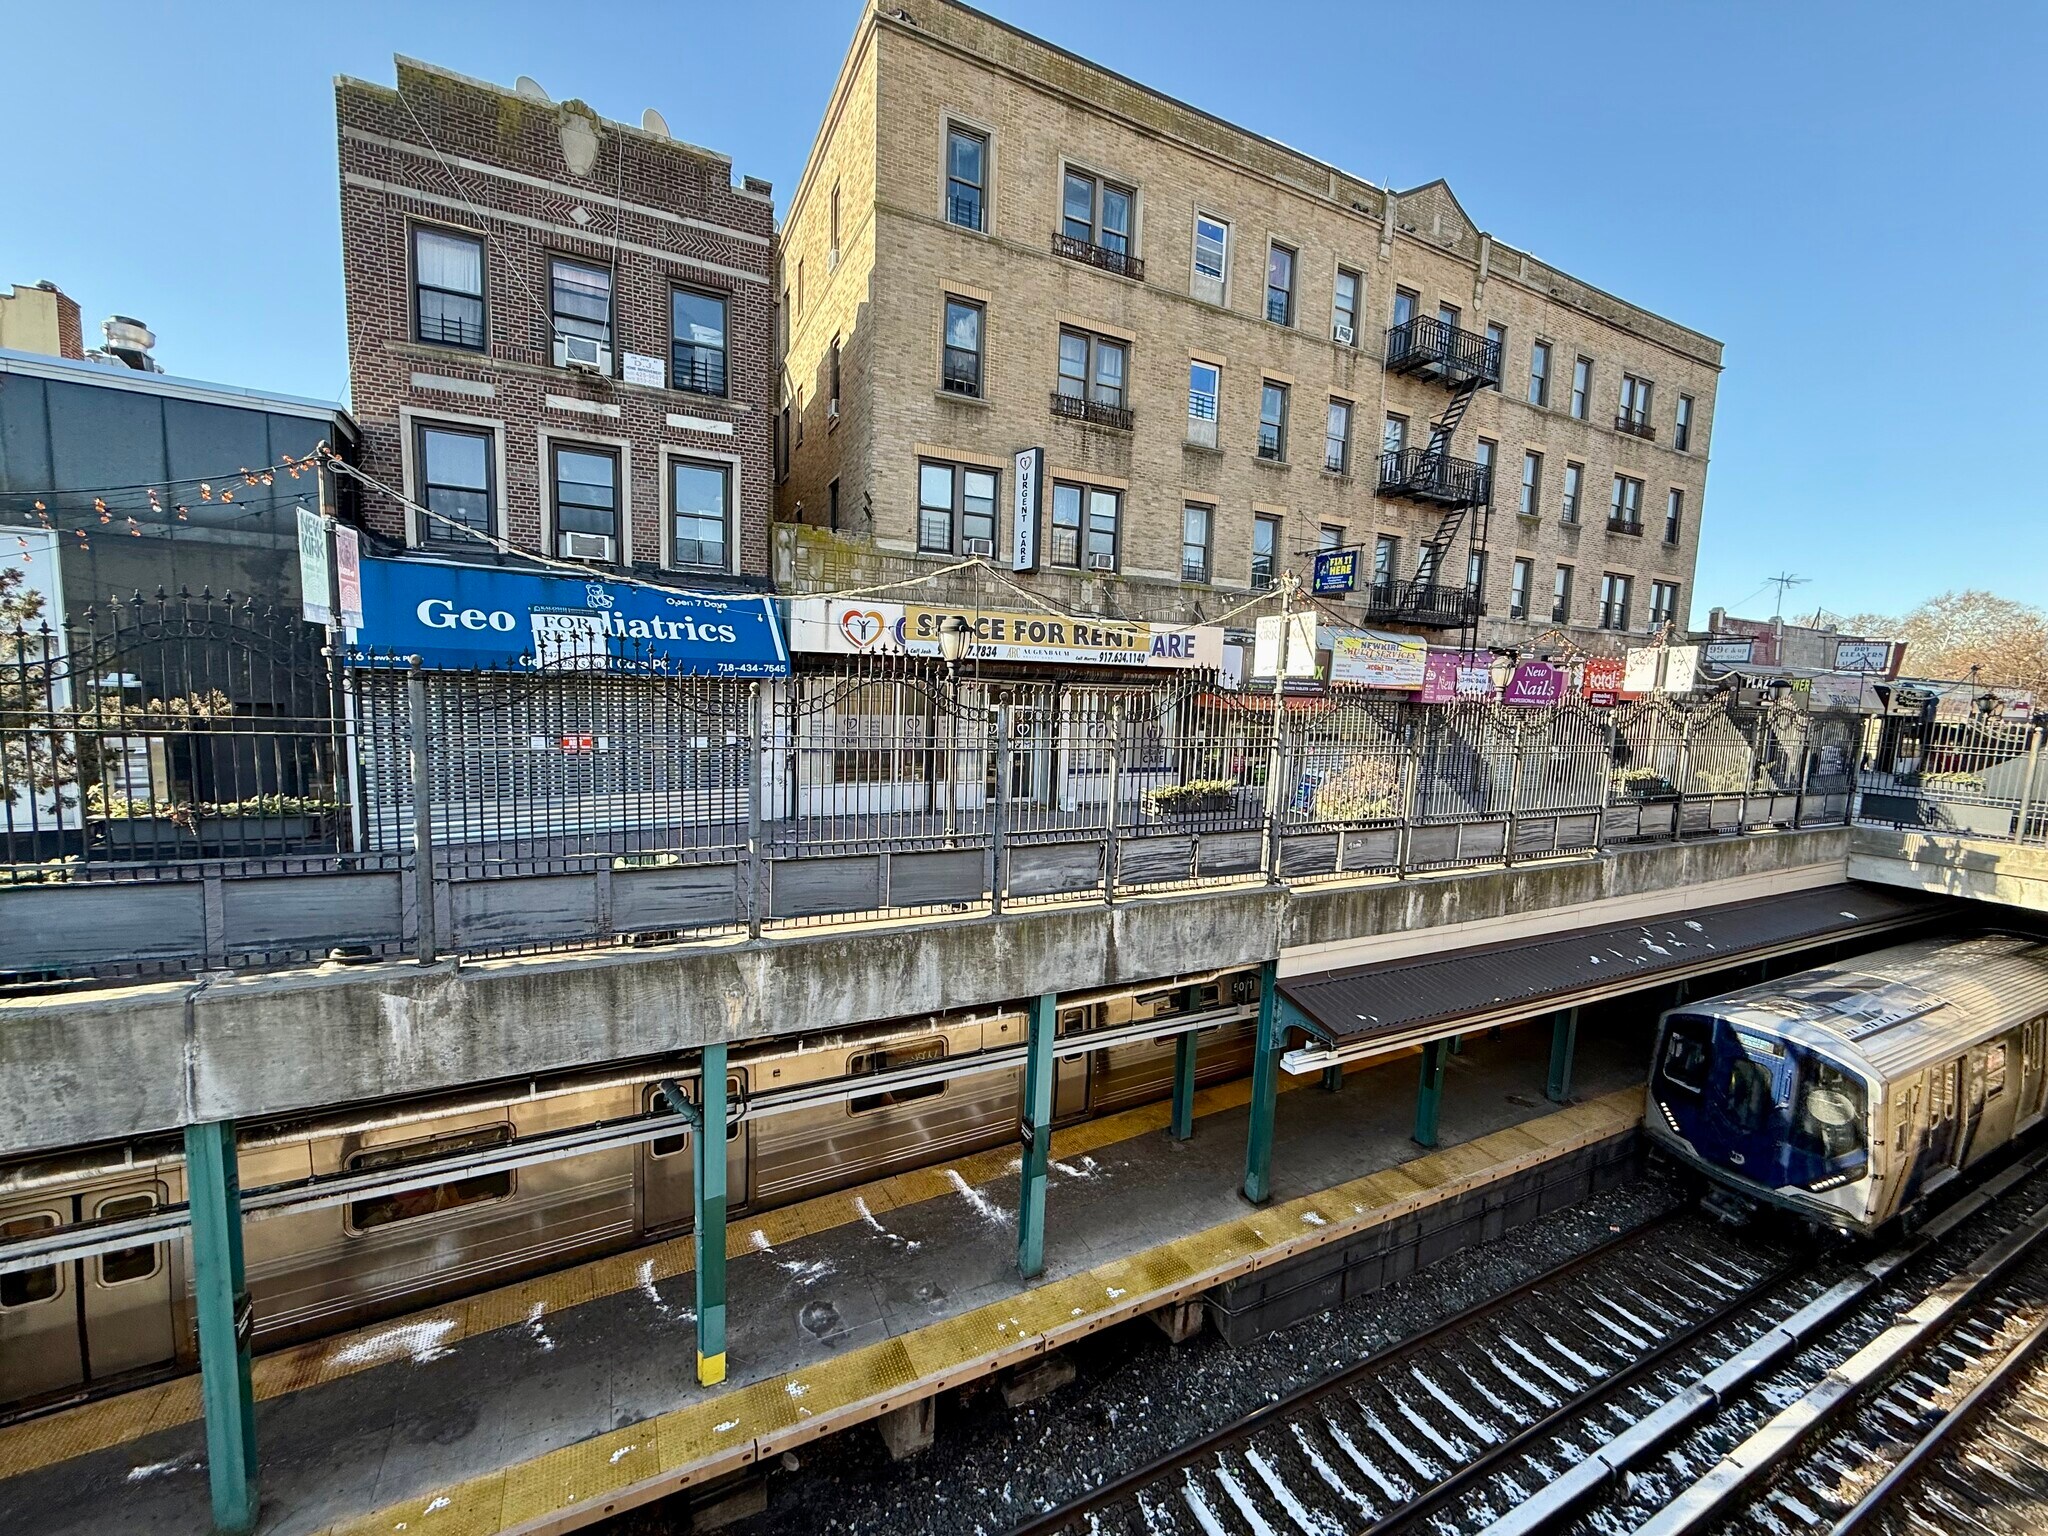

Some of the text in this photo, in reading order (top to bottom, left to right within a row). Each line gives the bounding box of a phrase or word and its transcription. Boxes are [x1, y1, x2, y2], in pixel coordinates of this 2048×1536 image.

[300, 512, 322, 540] NEW
[302, 532, 325, 559] KIRK
[1330, 555, 1353, 567] FIX IT
[1329, 564, 1352, 576] HERE
[666, 597, 694, 607] Open
[703, 600, 728, 609] Days
[417, 599, 516, 632] Geo
[543, 616, 590, 629] FOR
[917, 613, 1005, 640] SCE
[1014, 620, 1065, 644] FOR
[1073, 624, 1138, 647] RENT
[1151, 634, 1196, 658] ARE
[1098, 651, 1145, 664] 917.634.1140
[717, 662, 786, 673] 718-434-7545
[1524, 666, 1547, 677] New
[1514, 680, 1555, 696] Nails
